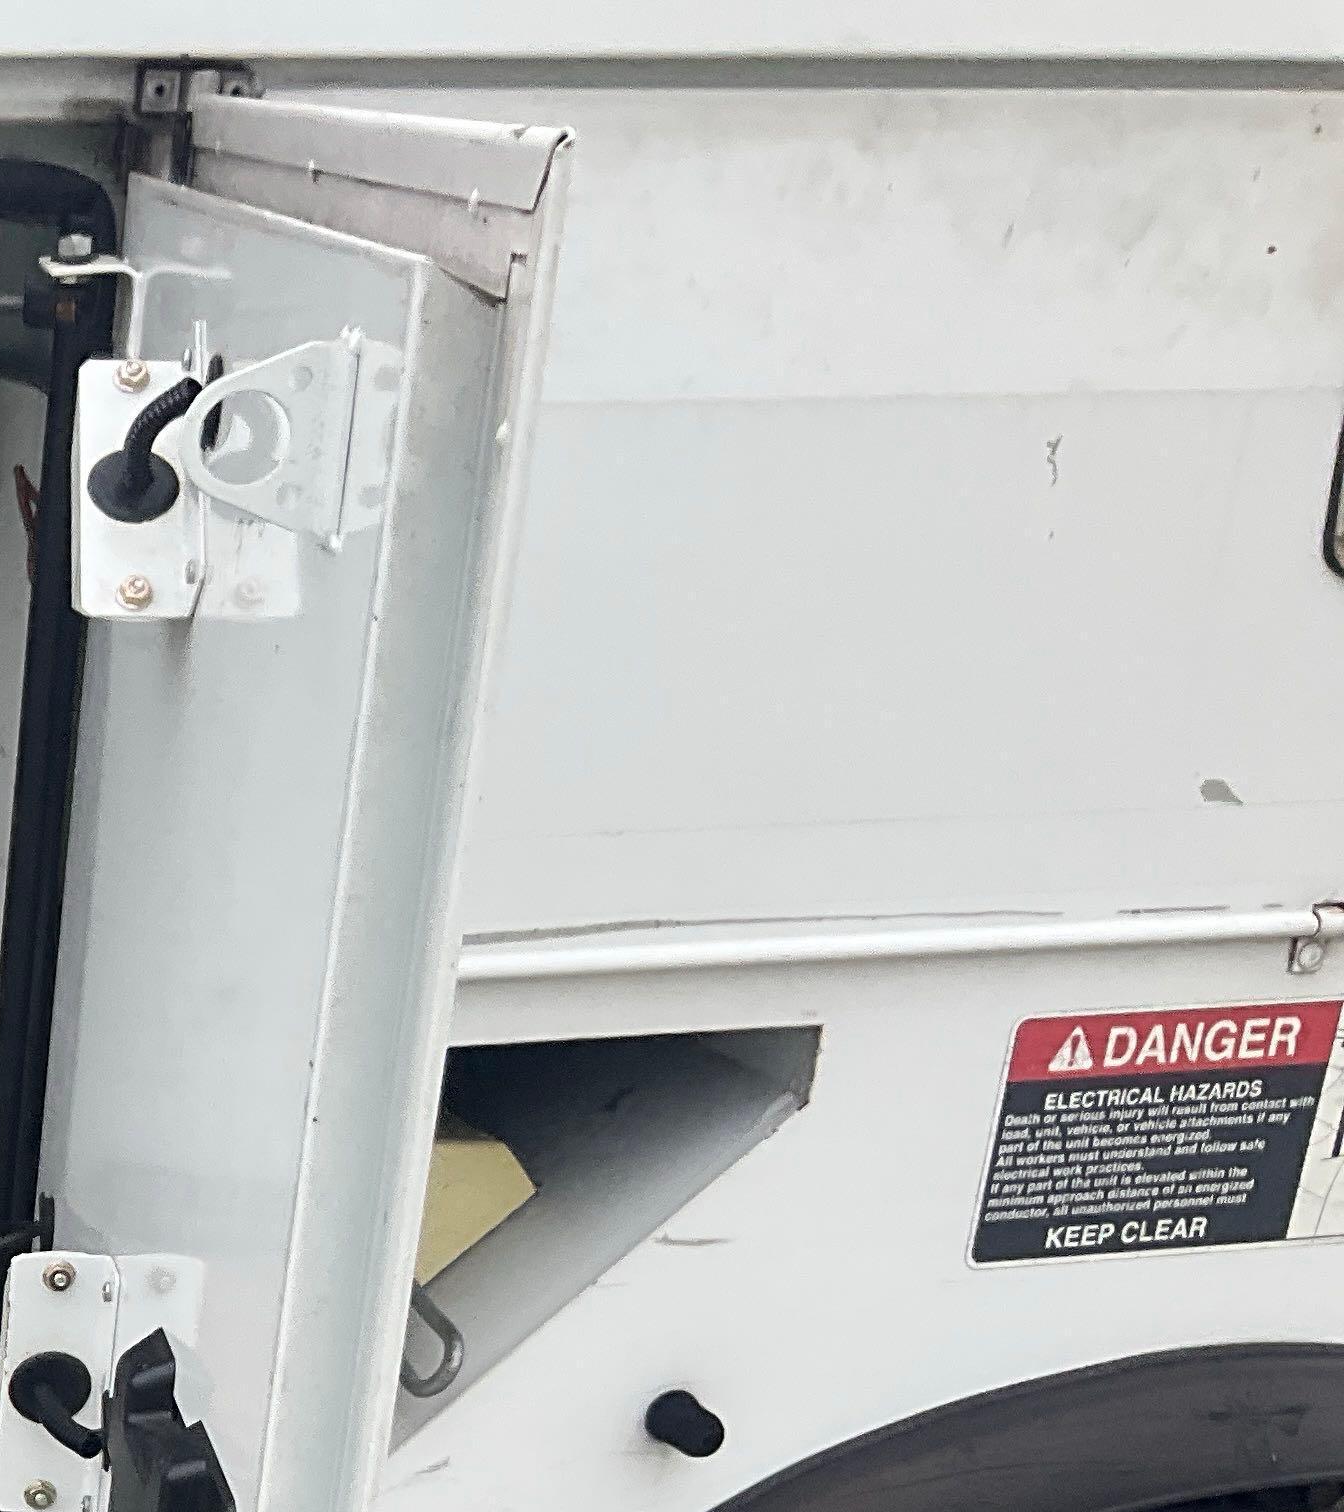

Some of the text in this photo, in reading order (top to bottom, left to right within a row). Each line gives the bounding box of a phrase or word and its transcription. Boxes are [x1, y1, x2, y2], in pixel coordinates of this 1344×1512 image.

[1103, 1016, 1302, 1067] DANGER
[1044, 1080, 1263, 1110] ELECTRICAL HAZARDS
[1044, 1114, 1057, 1123] or
[1109, 1108, 1144, 1121] injury
[1148, 1105, 1168, 1116] will
[1116, 1123, 1130, 1132] or
[1268, 1113, 1290, 1125] any
[999, 1143, 1024, 1155] part
[1027, 1142, 1040, 1152] of
[1043, 1139, 1062, 1150] the
[1066, 1138, 1090, 1149] unit
[996, 1156, 1013, 1166] All
[1017, 1153, 1064, 1165] workers
[1068, 1151, 1099, 1162] must
[1053, 1165, 1083, 1177] work
[1002, 1183, 1024, 1195] any
[1027, 1180, 1052, 1193] part
[1056, 1179, 1067, 1190] of
[1071, 1177, 1091, 1188] the
[1094, 1175, 1118, 1186] unit
[1228, 1167, 1247, 1178] the
[1045, 1217, 1207, 1249] KEEP CLEAR
